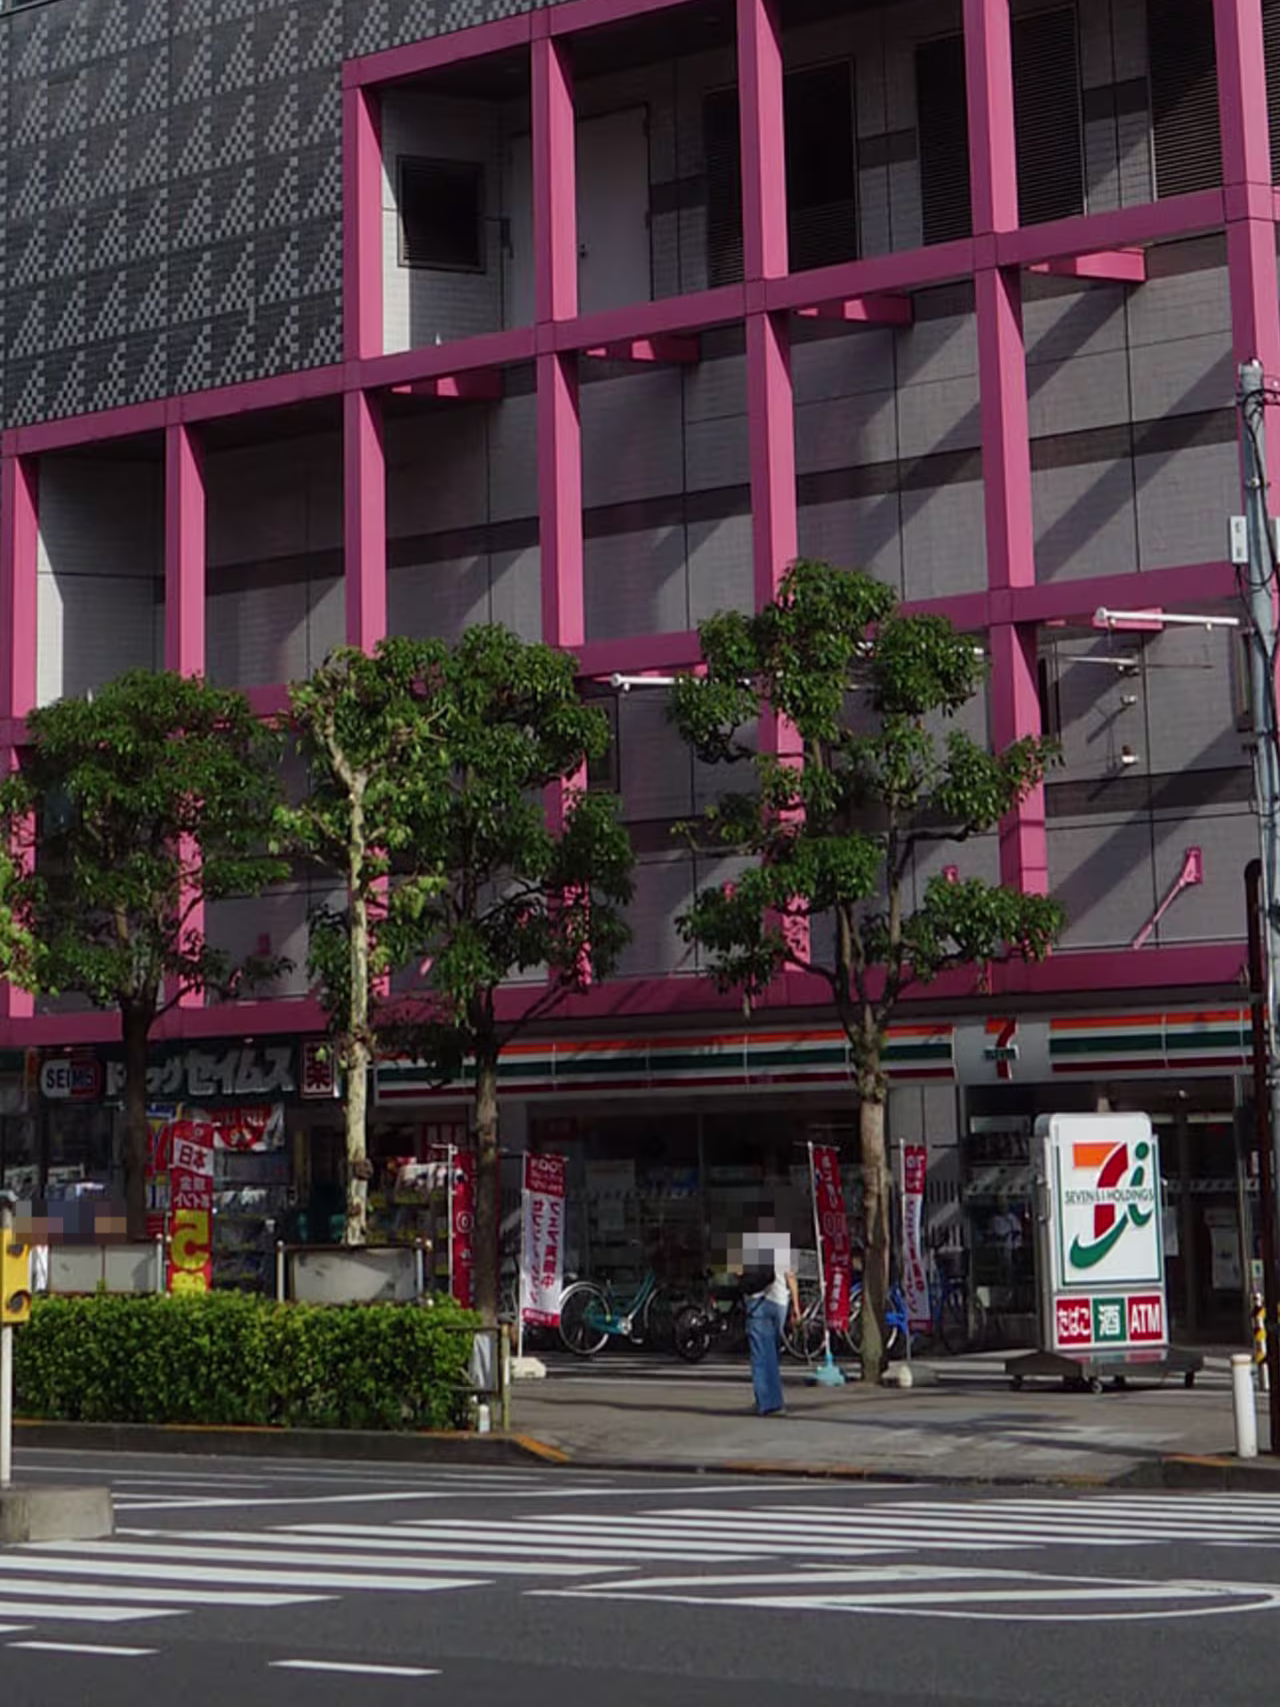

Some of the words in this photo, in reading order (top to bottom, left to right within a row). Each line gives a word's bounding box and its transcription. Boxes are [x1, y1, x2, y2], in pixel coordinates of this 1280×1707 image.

[46, 1067, 94, 1088] SEIMS
[105, 1046, 295, 1096] ドッグセイムス
[1064, 1189, 1094, 1204] SEVEN
[1057, 1306, 1090, 1337] たばこ
[1098, 1304, 1120, 1337] 酒
[1130, 1303, 1160, 1334] ATM
